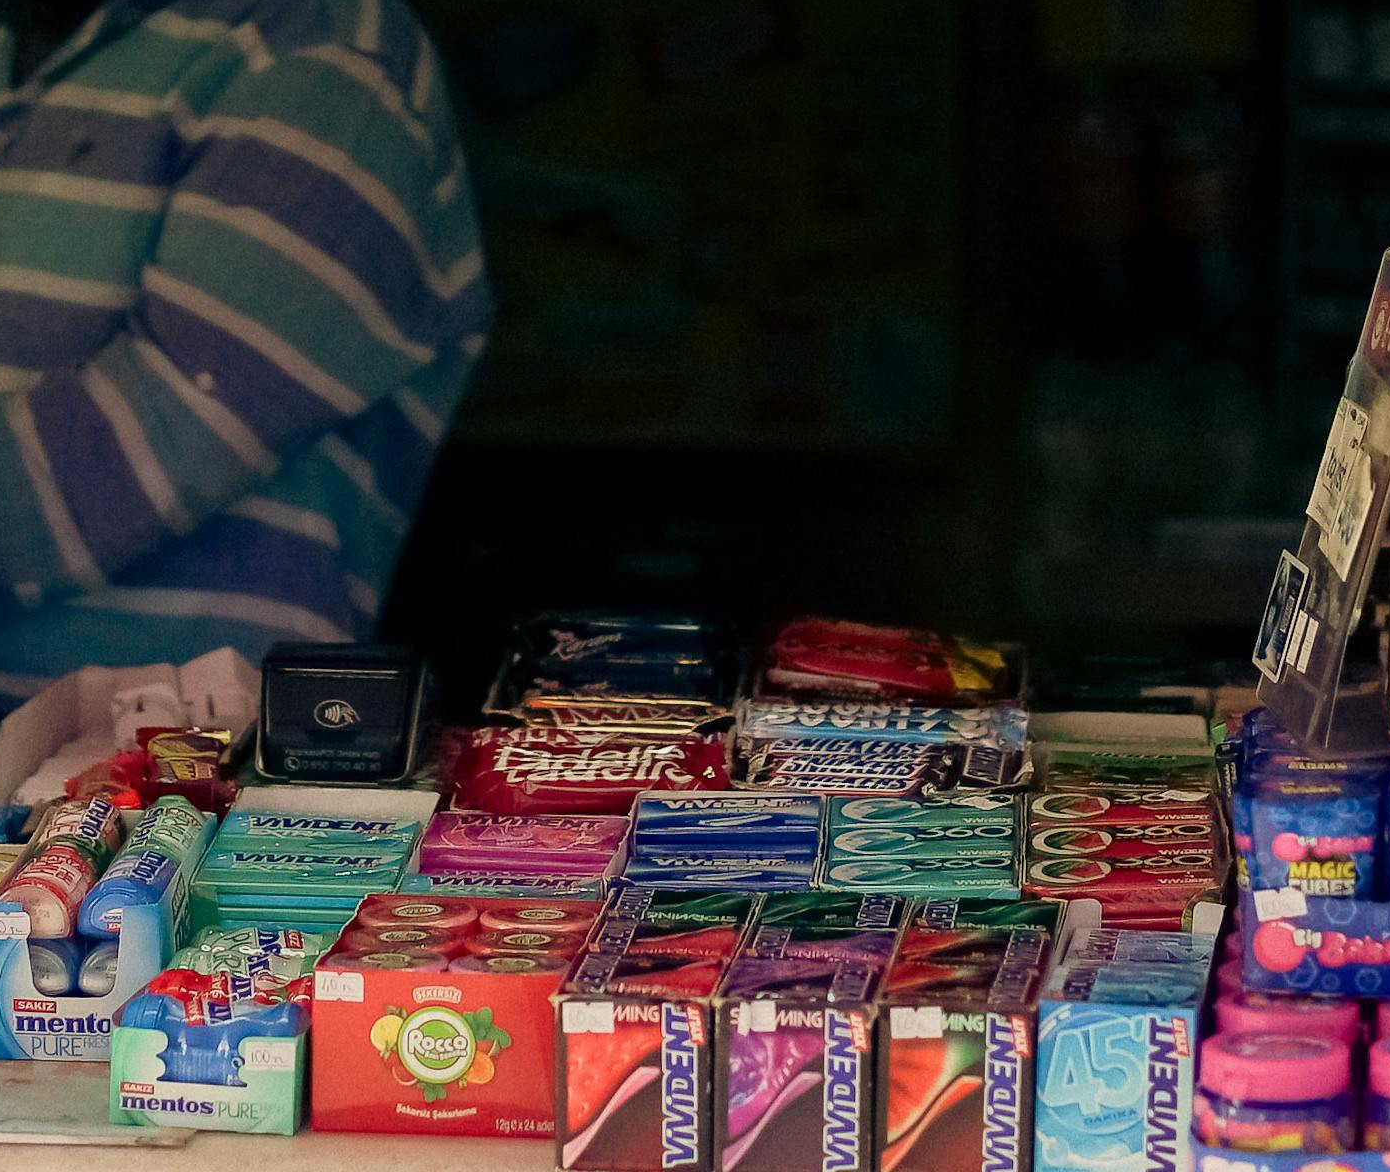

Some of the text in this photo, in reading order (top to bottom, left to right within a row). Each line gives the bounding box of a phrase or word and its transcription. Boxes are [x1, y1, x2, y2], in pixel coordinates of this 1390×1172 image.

[1288, 860, 1357, 879] MAGIC
[1288, 879, 1357, 896] CUBES
[16, 1000, 56, 1012] SAKIZ
[14, 1012, 111, 1035] mento
[31, 1037, 83, 1058] PURE
[119, 1095, 260, 1120] mentos PURE
